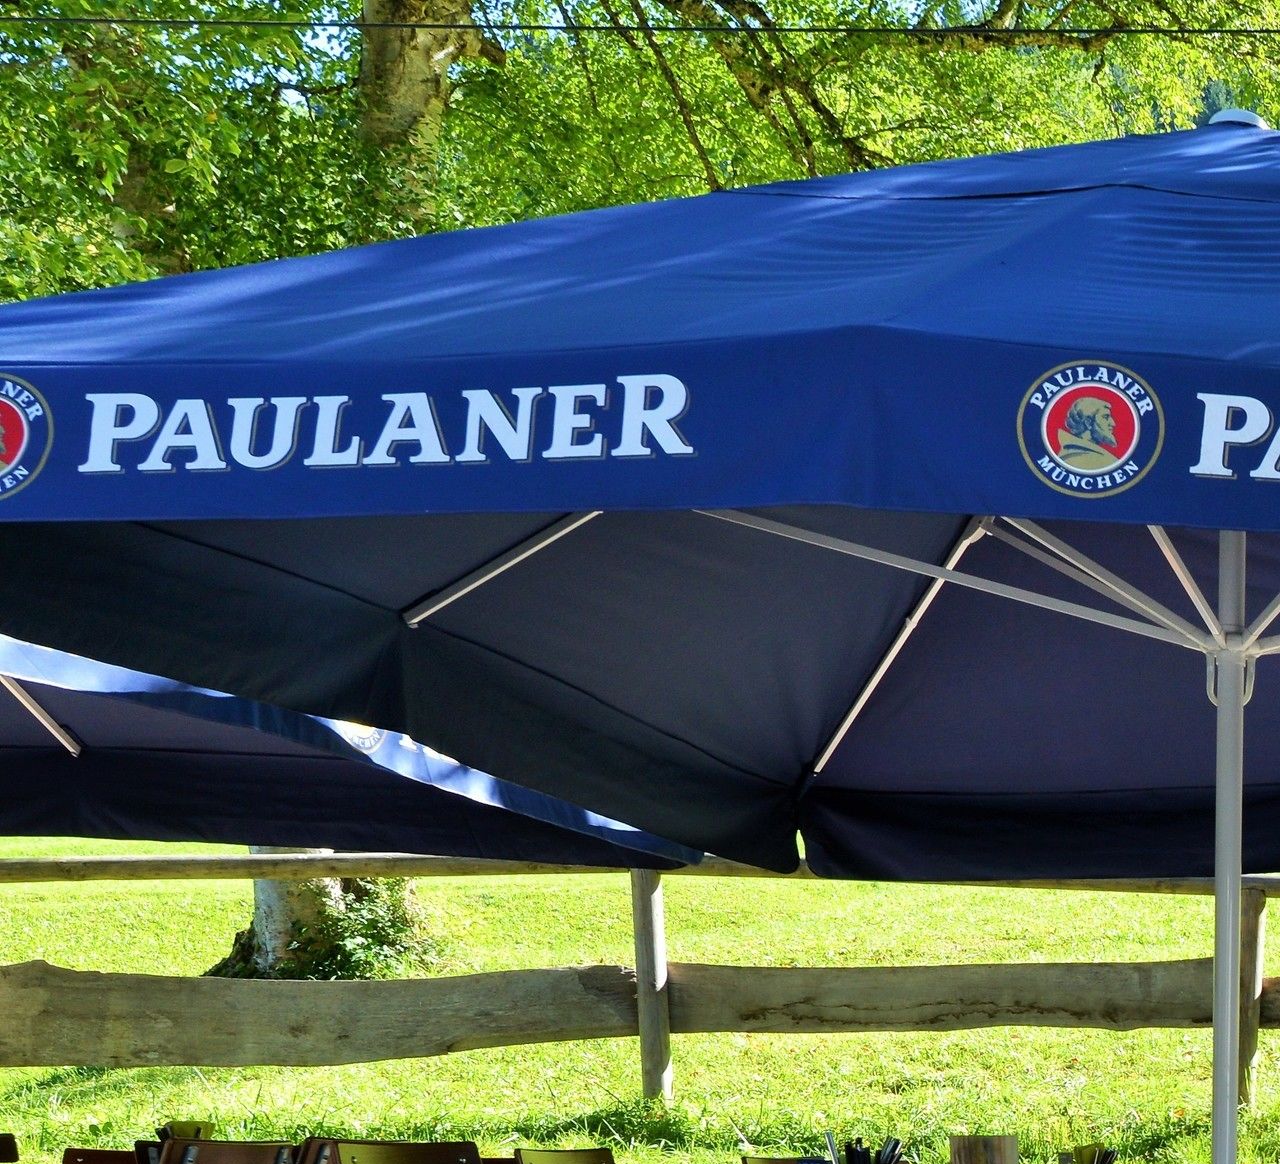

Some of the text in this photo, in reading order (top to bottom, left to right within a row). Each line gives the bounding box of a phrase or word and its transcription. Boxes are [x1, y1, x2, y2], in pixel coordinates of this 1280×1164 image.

[0, 380, 44, 421] NER
[1030, 367, 1154, 416] PAULANER
[77, 373, 696, 474] PAULANER
[1037, 455, 1139, 490] MÜNCHEN
